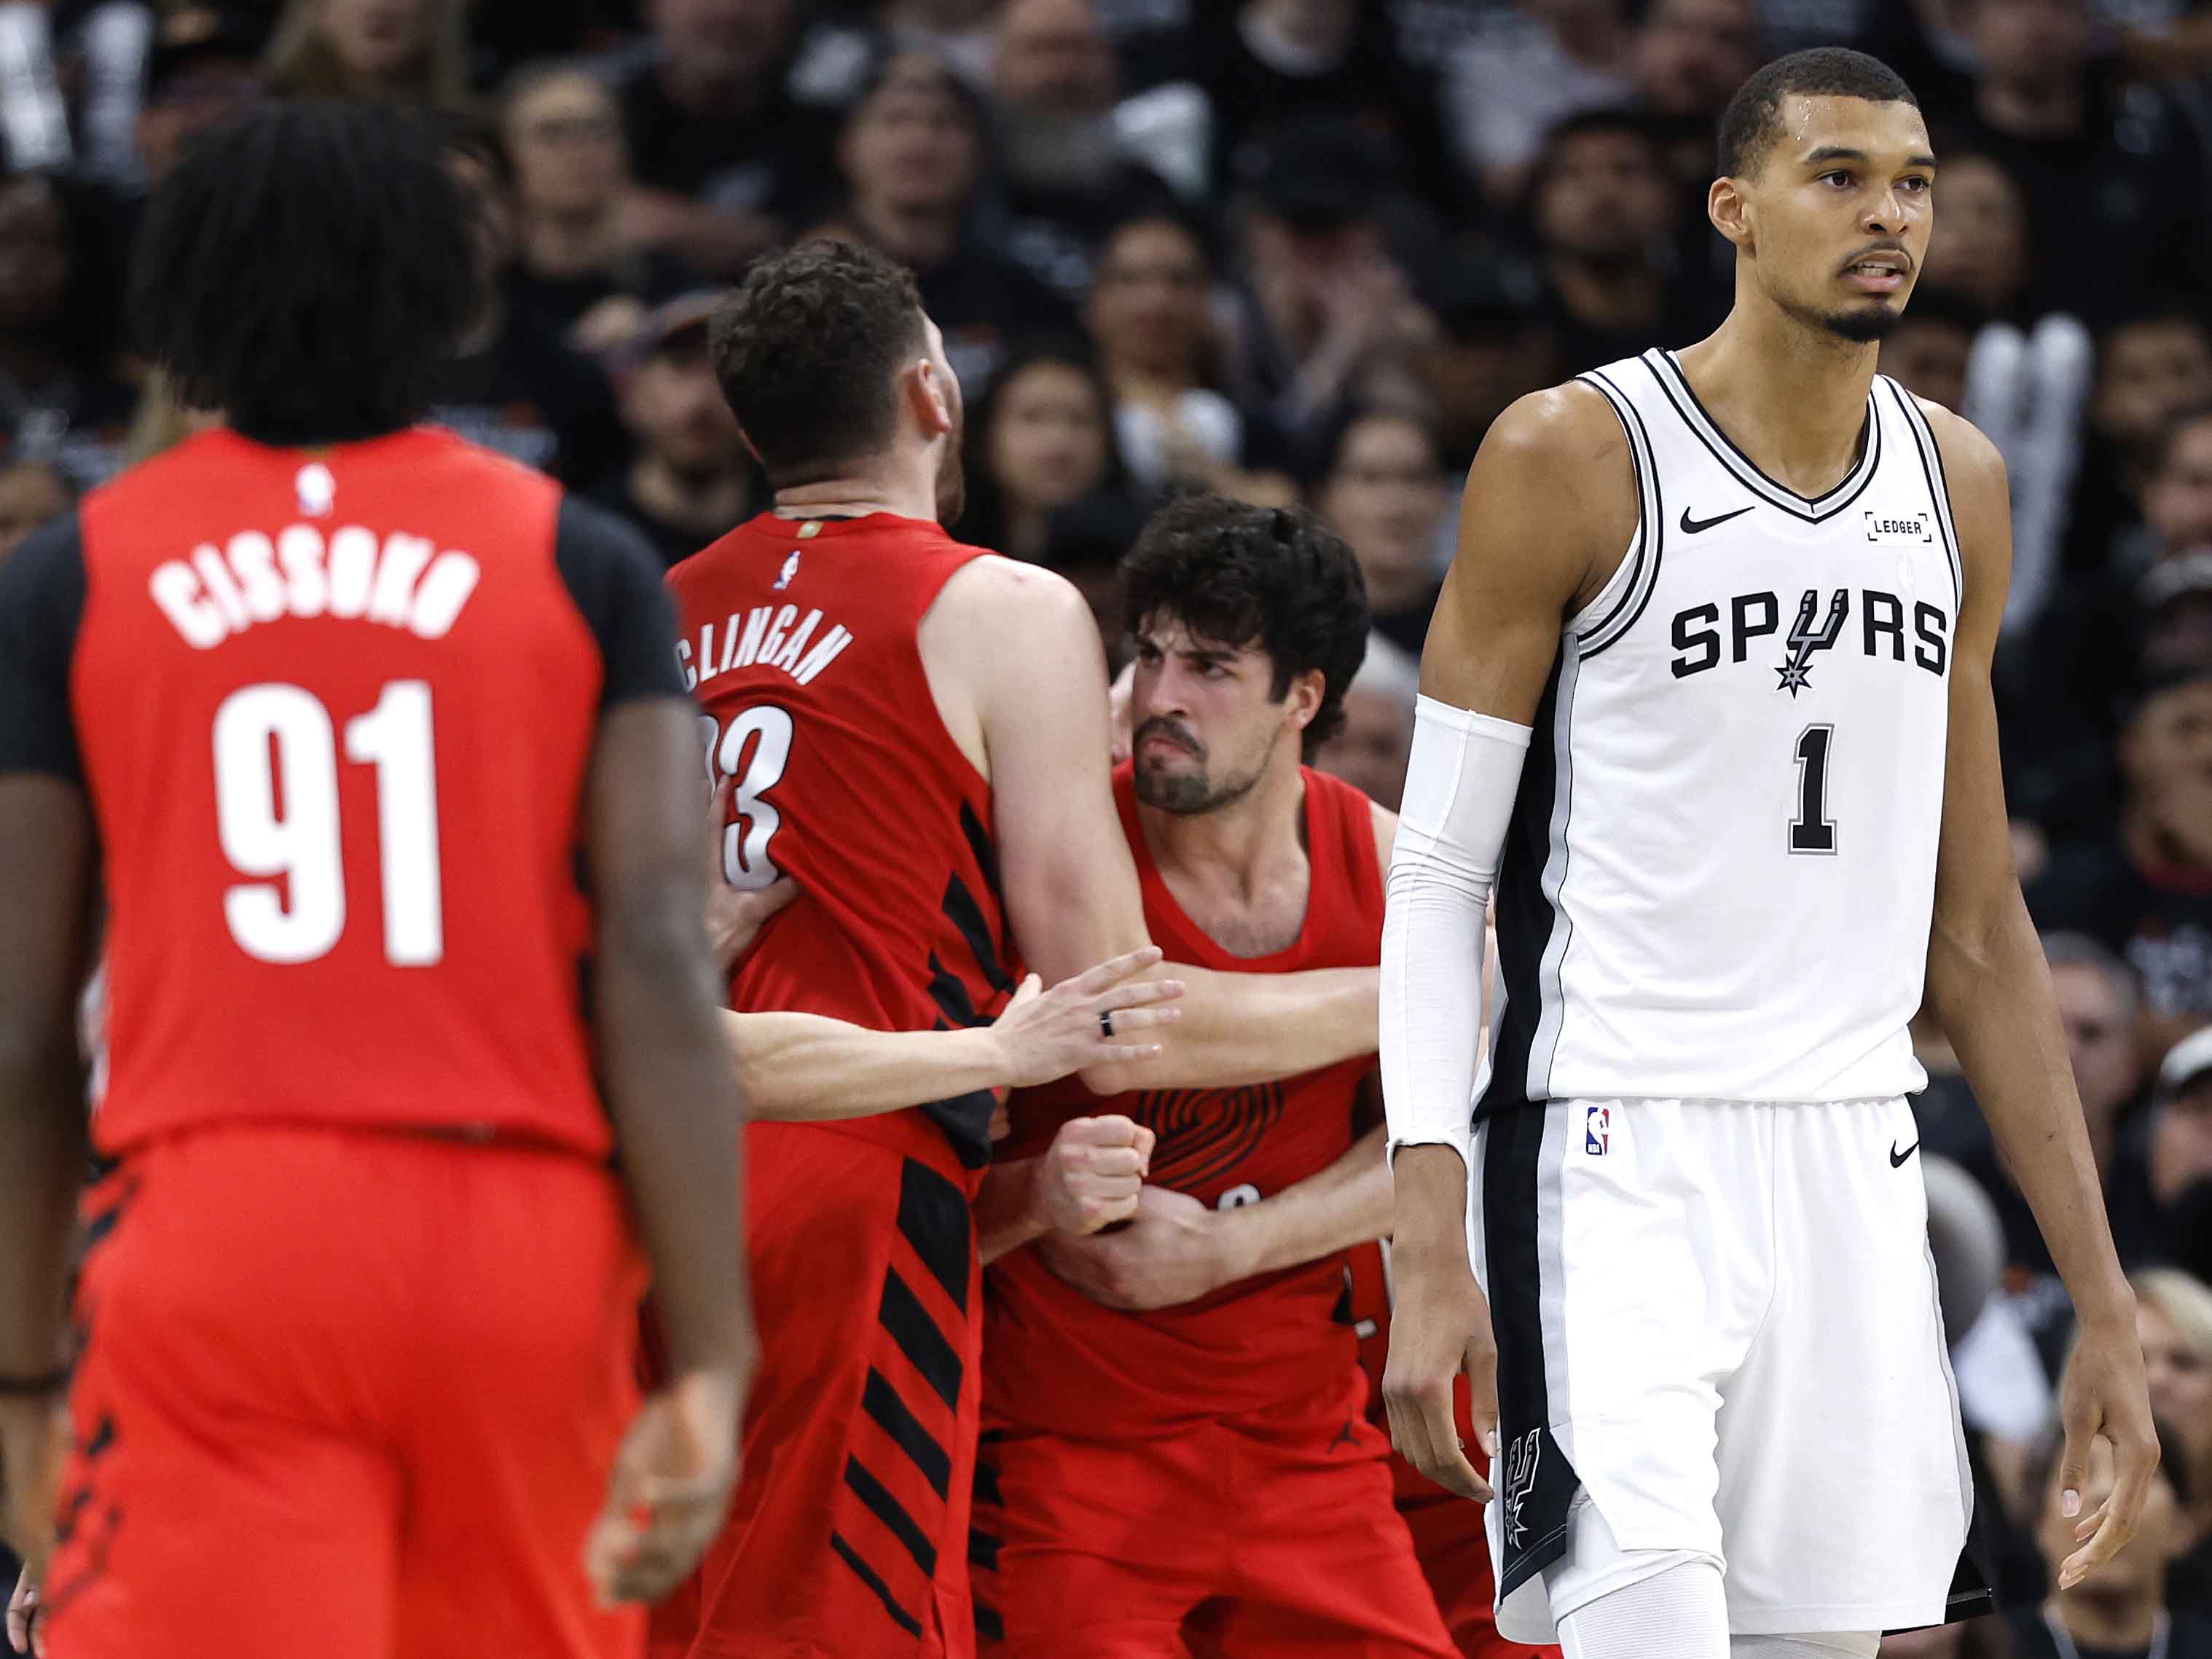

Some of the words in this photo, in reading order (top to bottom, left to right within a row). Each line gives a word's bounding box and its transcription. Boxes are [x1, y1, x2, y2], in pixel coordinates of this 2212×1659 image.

[150, 524, 480, 648] CISSOKO
[1874, 519, 1922, 535] LEDGER
[676, 604, 853, 694] CLINGAN
[1671, 588, 1947, 699] SPURS
[213, 679, 444, 968] 91
[699, 705, 793, 890] 3
[1788, 723, 1837, 855] 1
